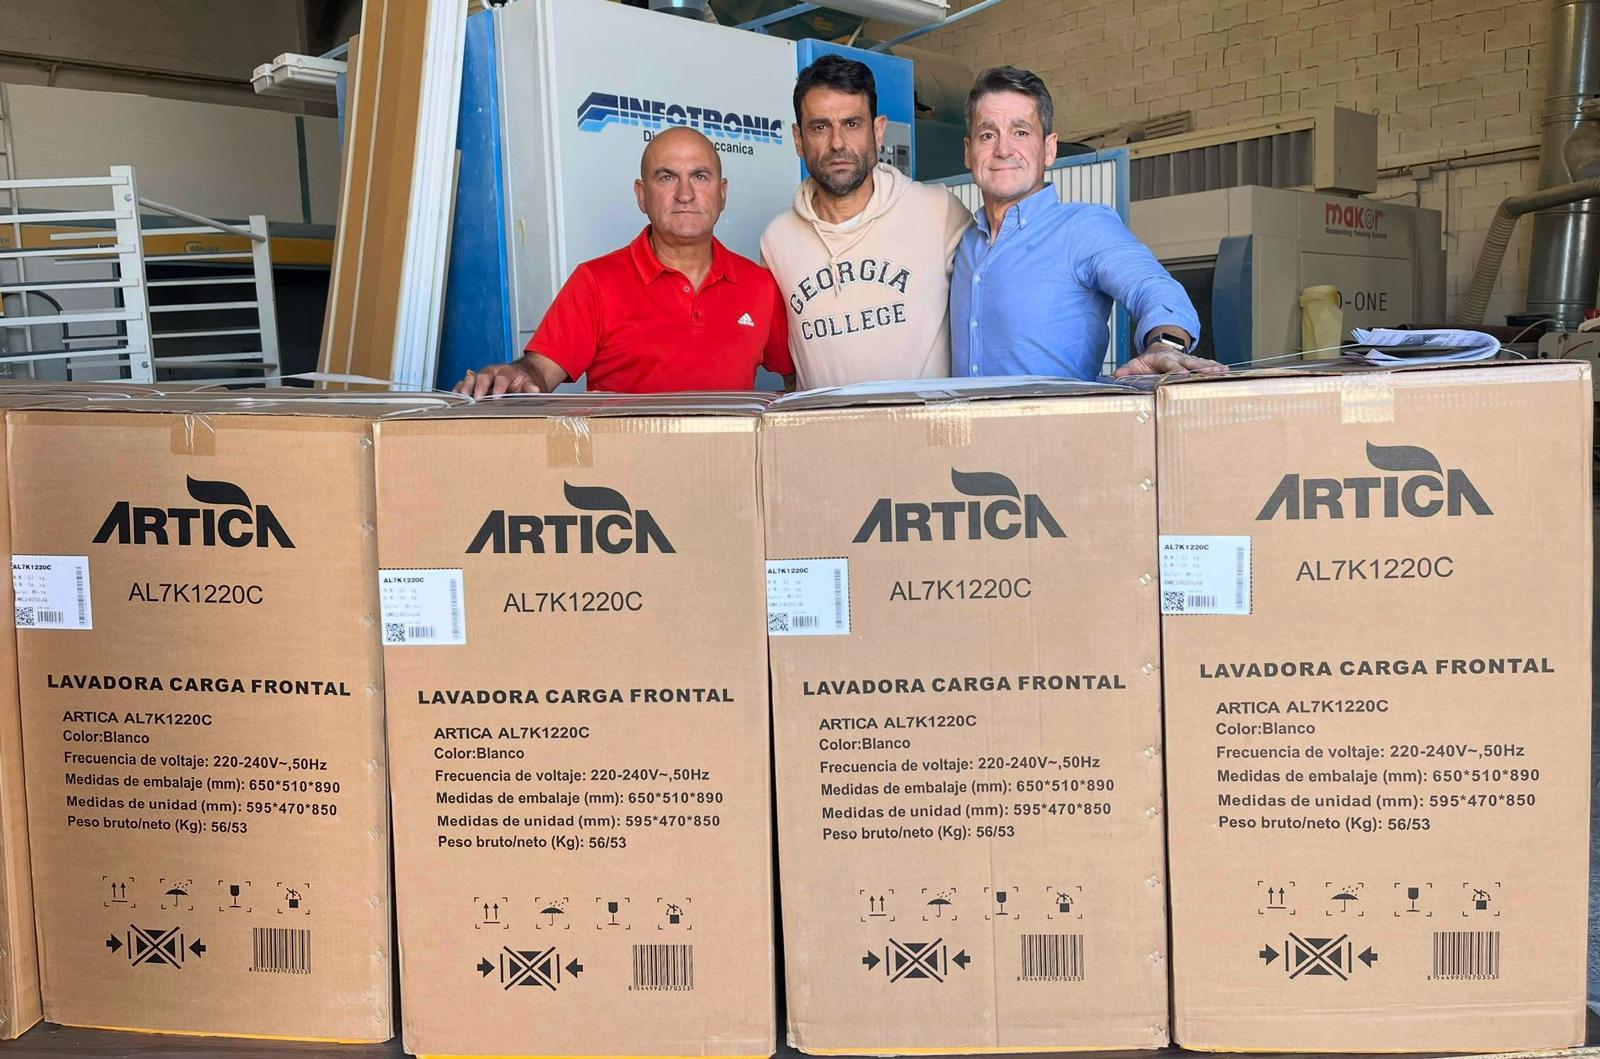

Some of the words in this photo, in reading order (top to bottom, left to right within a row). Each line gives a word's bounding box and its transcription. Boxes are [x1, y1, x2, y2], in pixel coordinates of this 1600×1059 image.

[619, 95, 783, 145] INFOTRONIC
[714, 142, 754, 155] ccanica
[1325, 203, 1383, 230] makor
[790, 259, 910, 315] GEORGIA
[802, 304, 906, 340] COLLEGE
[1255, 469, 1495, 520] ARTICA
[92, 501, 296, 548] ARTICA
[852, 494, 1067, 543] ARTICA
[465, 510, 677, 554] ARTICA
[1296, 556, 1454, 581] AL7K1220C
[129, 583, 263, 604] AL7K1220C
[890, 578, 1031, 601] AL7K1220C
[504, 591, 643, 612] AL7K1220C
[1200, 662, 1332, 678] LAVADORA
[1340, 660, 1428, 675] CARGA
[1436, 658, 1554, 674] FRONTAL
[48, 675, 163, 690] LAVADORA
[170, 678, 245, 692] CARGA
[252, 680, 350, 696] FRONTAL
[803, 679, 925, 695] LAVADORA
[932, 677, 1011, 692] CARGA
[1019, 675, 1126, 690] FRONTAL
[418, 690, 539, 704] LAVADORA
[546, 689, 623, 703] CARGA
[631, 689, 734, 702] FRONTAL
[1216, 702, 1280, 714] ARTICA
[1287, 700, 1388, 713] AL7K1220C
[63, 711, 119, 723] ARTICA
[124, 713, 212, 725] AL7K1220C
[819, 718, 878, 730] ARTICA
[884, 715, 976, 728] AL7K1220C
[63, 730, 149, 743] Color:Blanco
[434, 728, 492, 739] ARTICA
[498, 727, 589, 739] AL7K1220C
[1216, 722, 1315, 735] Color:Blanco
[820, 738, 910, 750] Color:Blanco
[64, 752, 136, 765] Frecuencia
[141, 754, 156, 765] de
[160, 755, 208, 769] voltaje:
[434, 747, 524, 759] Color:Blanco
[1217, 746, 1300, 758] Frecuencia
[1305, 746, 1323, 757] de
[1328, 746, 1384, 761] voltaje:
[821, 760, 896, 773] Frecuencia
[902, 759, 918, 771] de
[923, 758, 973, 773] voltaje:
[66, 773, 119, 786] Medidas
[124, 775, 139, 786] de
[143, 776, 202, 791] embalaje
[207, 777, 244, 792] (mm):
[436, 770, 511, 781] Frecuencia
[516, 770, 531, 781] de
[536, 770, 585, 784] voltaje:
[1218, 770, 1280, 782] Medidas
[1286, 770, 1303, 782] de
[1309, 770, 1377, 785] embalaje
[1383, 769, 1427, 785] (mm):
[822, 783, 879, 795] Medidas
[884, 783, 900, 794] de
[905, 781, 967, 796] embalaje
[972, 780, 1011, 795] (mm):
[67, 796, 124, 808] Medidas
[129, 798, 144, 809] de
[149, 799, 196, 810] unidad
[201, 800, 241, 815] (mm):
[437, 792, 493, 803] Medidas
[498, 792, 514, 803] de
[519, 792, 579, 806] embalaje
[585, 792, 623, 806] (mm):
[1219, 794, 1286, 806] Medidas
[1291, 795, 1310, 806] de
[1315, 795, 1371, 807] unidad
[1377, 795, 1423, 810] (mm):
[823, 807, 884, 818] Medidas
[889, 806, 905, 817] de
[911, 805, 961, 817] unidad
[966, 804, 1008, 818] (mm):
[68, 816, 99, 827] Peso
[104, 817, 170, 829] bruto/neto
[175, 819, 206, 833] (Kg):
[212, 822, 247, 833] 56/53
[438, 816, 498, 826] Medidas
[503, 816, 519, 826] de
[524, 816, 574, 826] unidad
[579, 815, 620, 829] (mm):
[1219, 816, 1256, 828] Peso
[1262, 816, 1340, 829] bruto/neto
[1346, 817, 1382, 832] (Kg):
[1388, 818, 1430, 830] 56/53
[823, 828, 857, 840] Peso
[862, 826, 933, 839] bruto/neto
[938, 825, 971, 840] (Kg):
[977, 826, 1014, 837] 56/53
[439, 836, 472, 847] Peso
[477, 835, 546, 847] bruto/neto
[552, 836, 583, 850] (Kg):
[589, 836, 626, 848] 56/53
